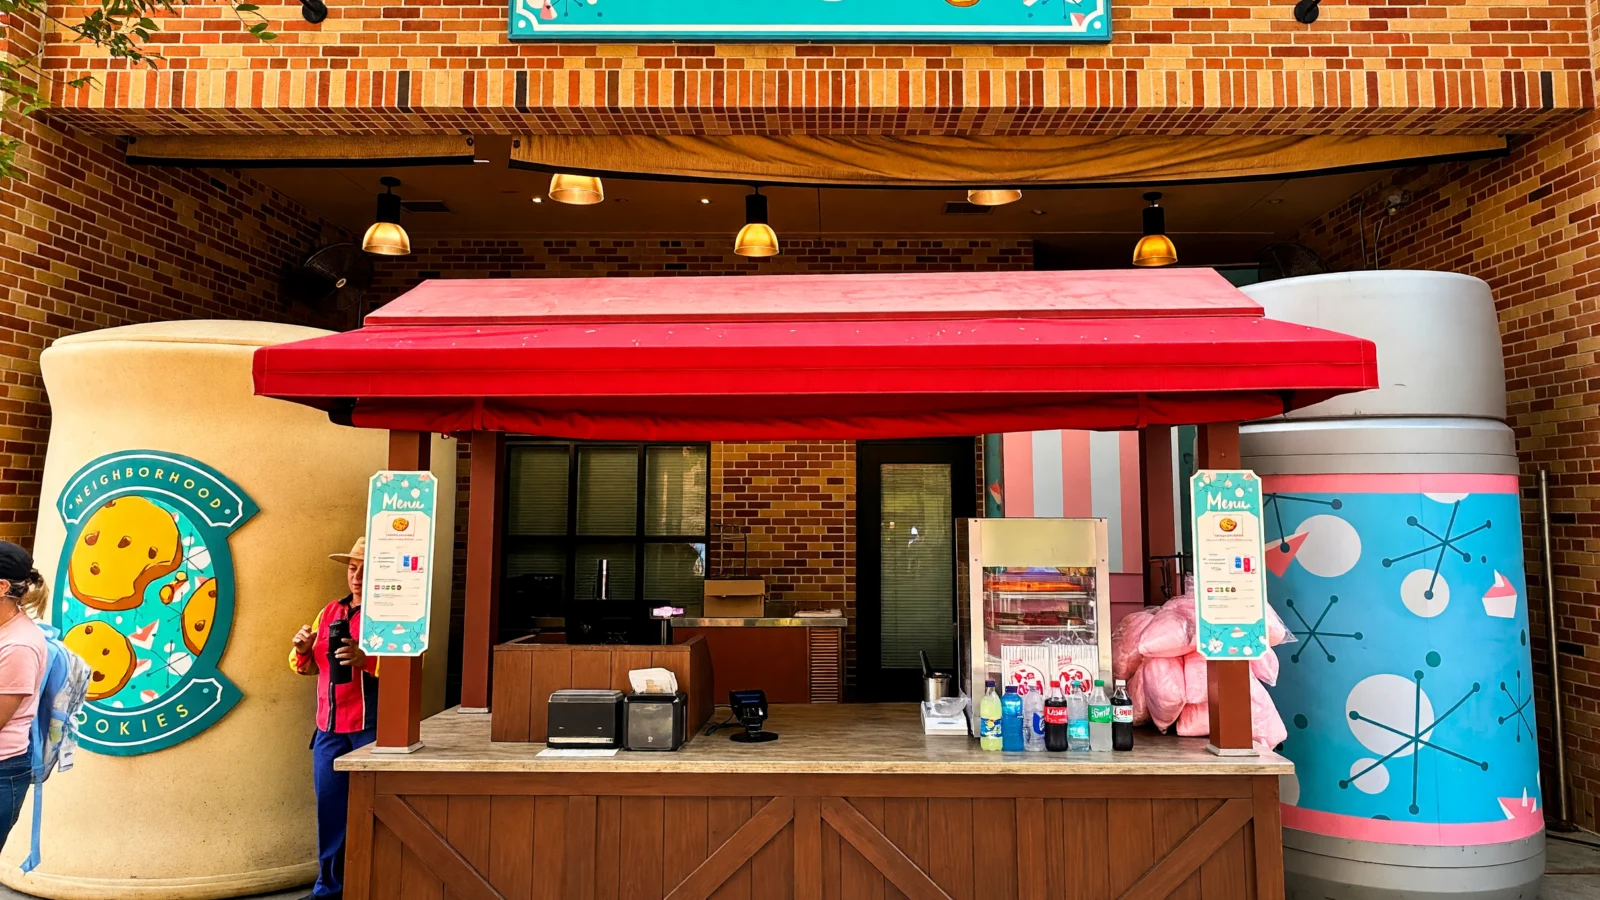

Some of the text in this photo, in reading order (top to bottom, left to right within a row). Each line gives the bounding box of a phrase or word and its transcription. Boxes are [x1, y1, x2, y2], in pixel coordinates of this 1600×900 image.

[75, 467, 221, 508] NEIGHBORHOOD
[382, 492, 425, 510] Menu
[1206, 491, 1251, 510] Menu
[77, 704, 189, 735] OOKIES
